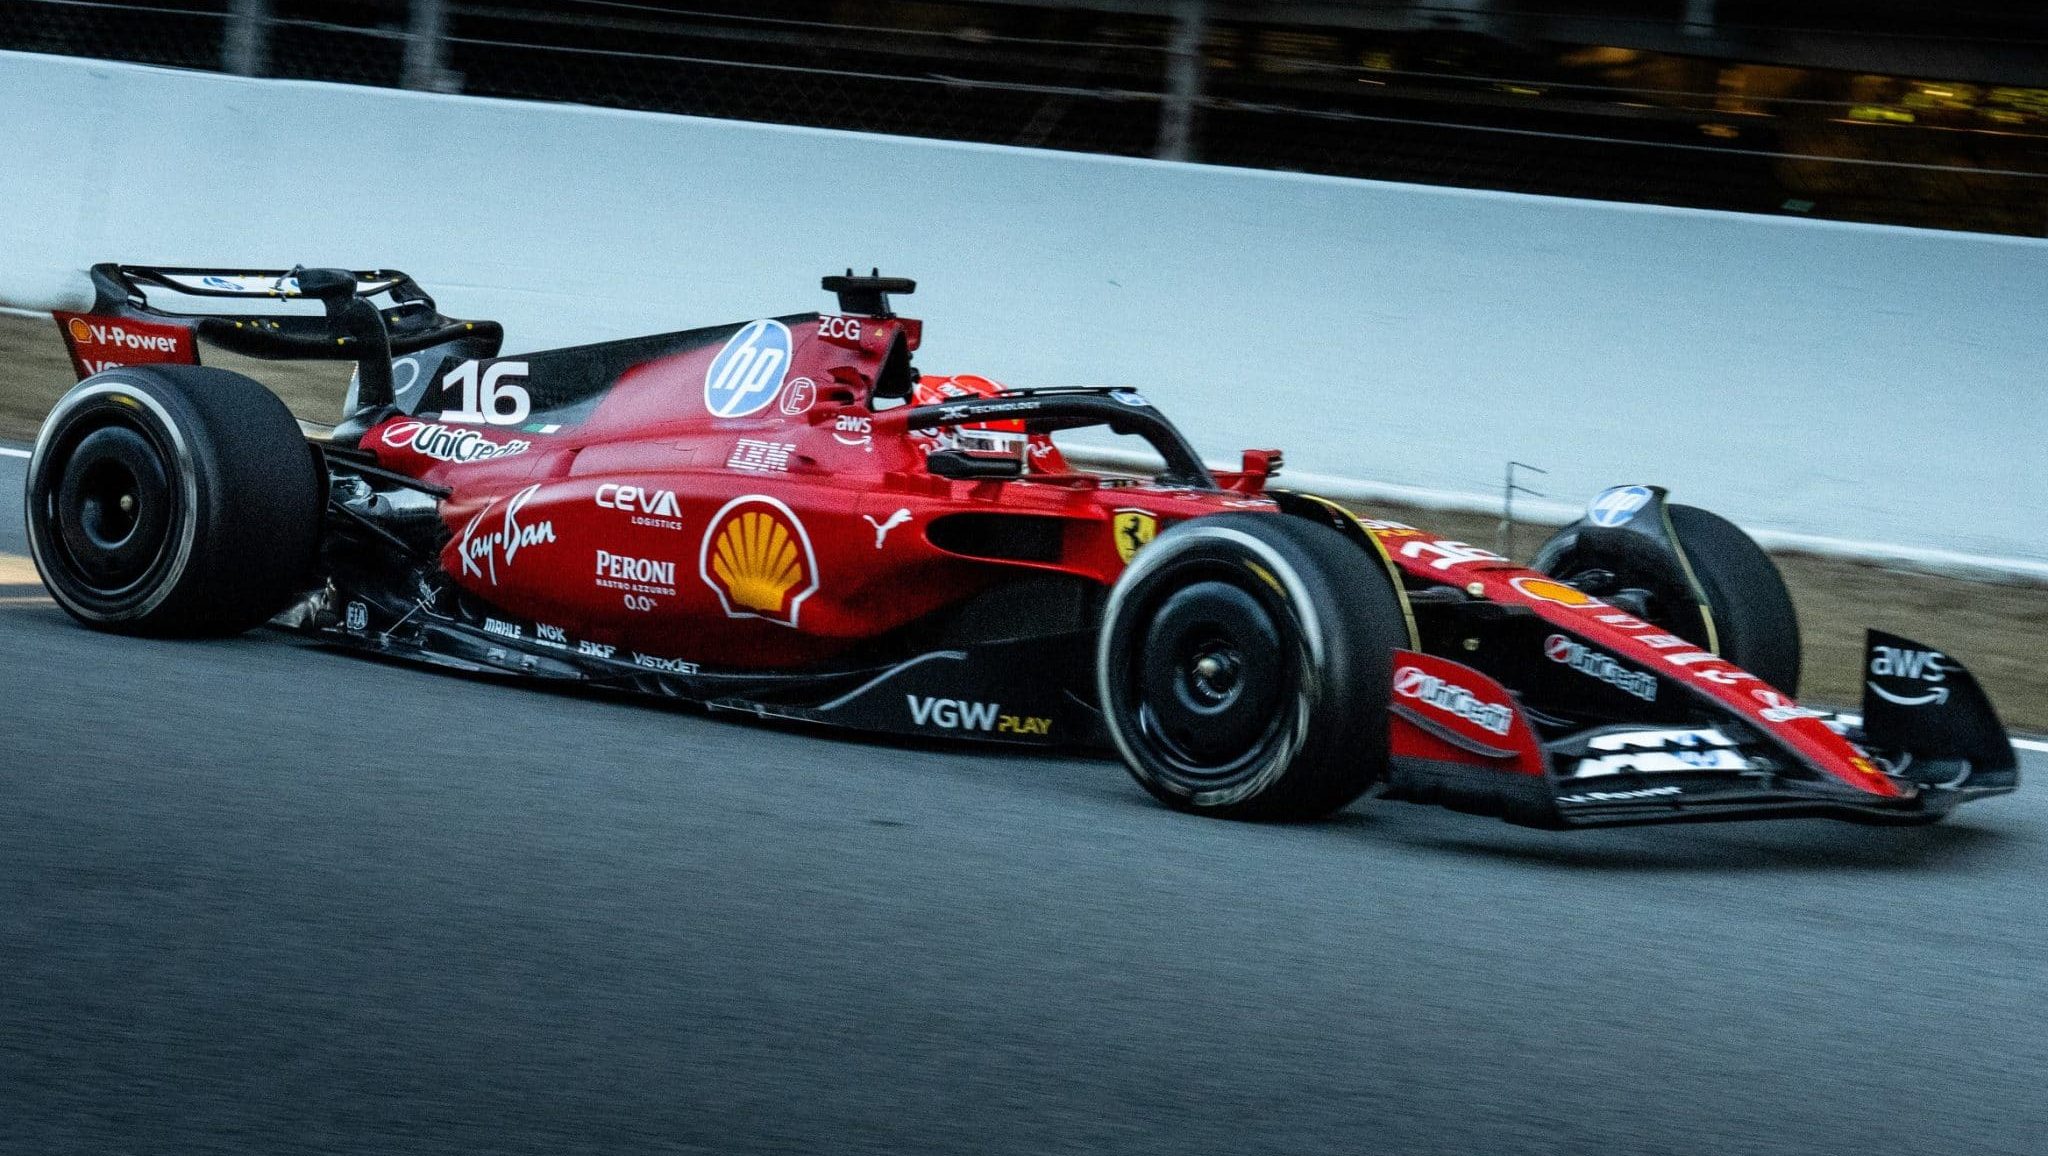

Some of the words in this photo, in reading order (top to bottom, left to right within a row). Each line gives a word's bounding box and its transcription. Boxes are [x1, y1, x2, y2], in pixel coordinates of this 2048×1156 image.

[91, 324, 177, 352] V-Power
[709, 320, 787, 416] hp
[438, 359, 531, 425] 16
[835, 414, 873, 434] aws
[412, 423, 531, 463] UniCredit
[727, 438, 797, 472] IBM
[631, 515, 682, 530] LOGISTICS
[596, 549, 676, 585] PERONI
[483, 617, 521, 639] MAHLE
[536, 621, 567, 642] NGK
[578, 640, 616, 659] SKF
[632, 651, 700, 675] VISTAJET
[1870, 645, 1947, 682] aws
[907, 694, 1000, 731] VGW
[998, 714, 1053, 735] PLAY
